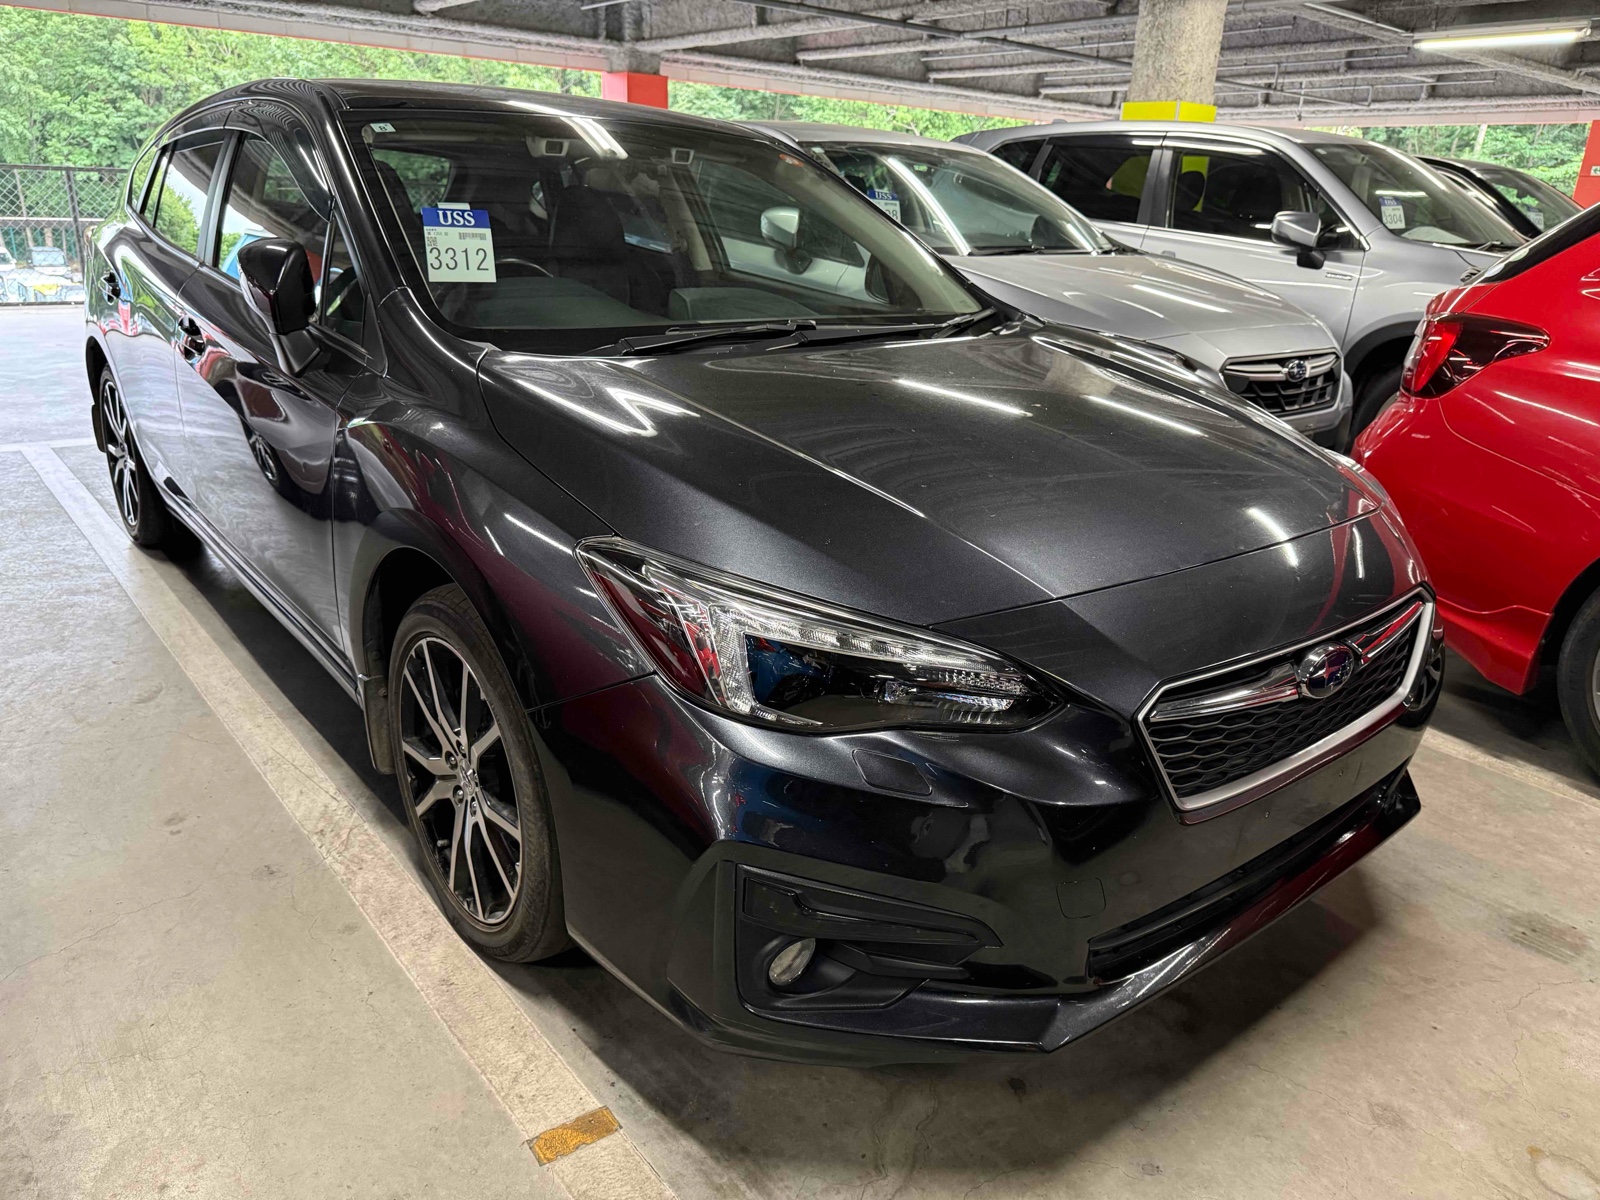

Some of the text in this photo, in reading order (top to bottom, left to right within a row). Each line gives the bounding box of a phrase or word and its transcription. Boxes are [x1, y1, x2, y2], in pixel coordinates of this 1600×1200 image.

[875, 191, 893, 200] USS
[437, 210, 476, 226] USS
[429, 247, 490, 271] 3312
